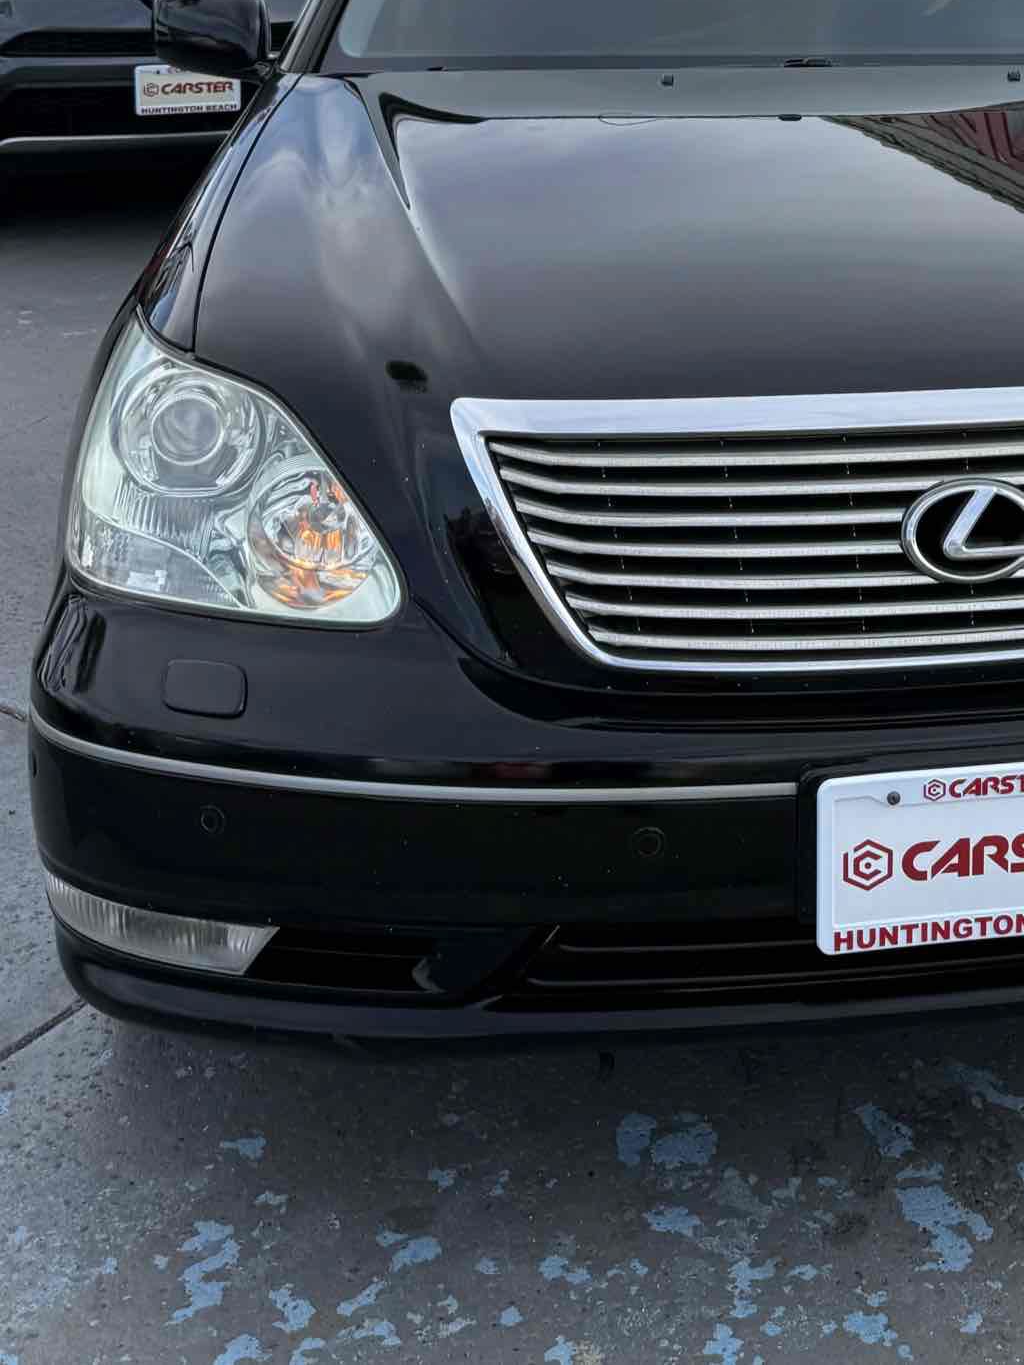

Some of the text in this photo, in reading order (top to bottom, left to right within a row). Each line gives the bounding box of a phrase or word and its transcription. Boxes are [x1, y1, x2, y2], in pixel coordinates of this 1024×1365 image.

[161, 81, 234, 95] CARSTER
[141, 103, 237, 115] HUNTINGTON BEACH
